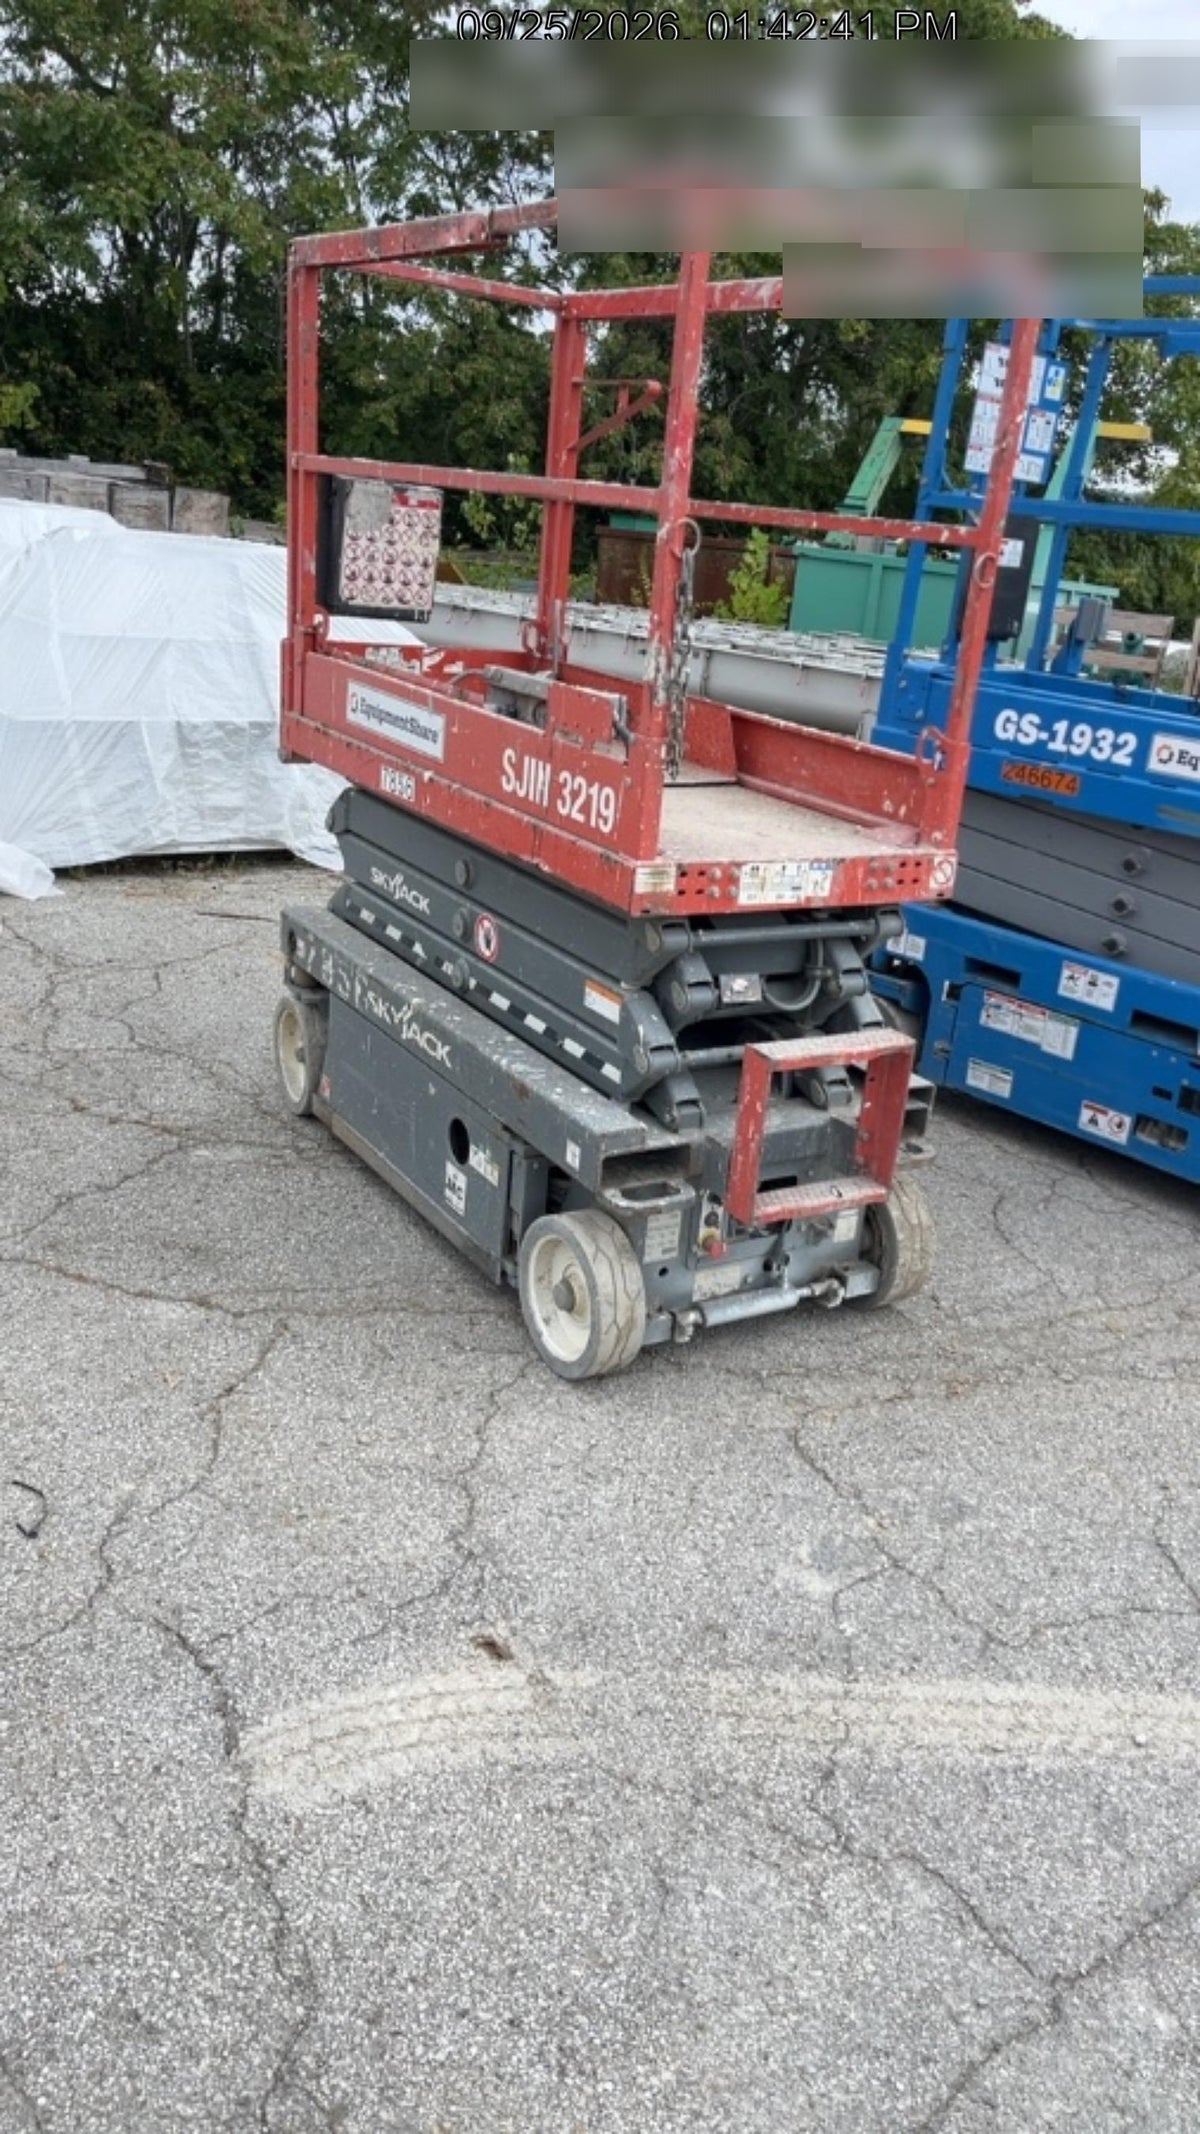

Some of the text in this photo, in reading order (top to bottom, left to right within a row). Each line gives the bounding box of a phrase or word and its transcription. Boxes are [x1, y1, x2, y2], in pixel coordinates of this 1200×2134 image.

[994, 708, 1137, 767] GS-1932
[556, 770, 616, 833] 3219
[371, 866, 430, 915] SKYJACK
[366, 990, 452, 1068] SKYJACK
